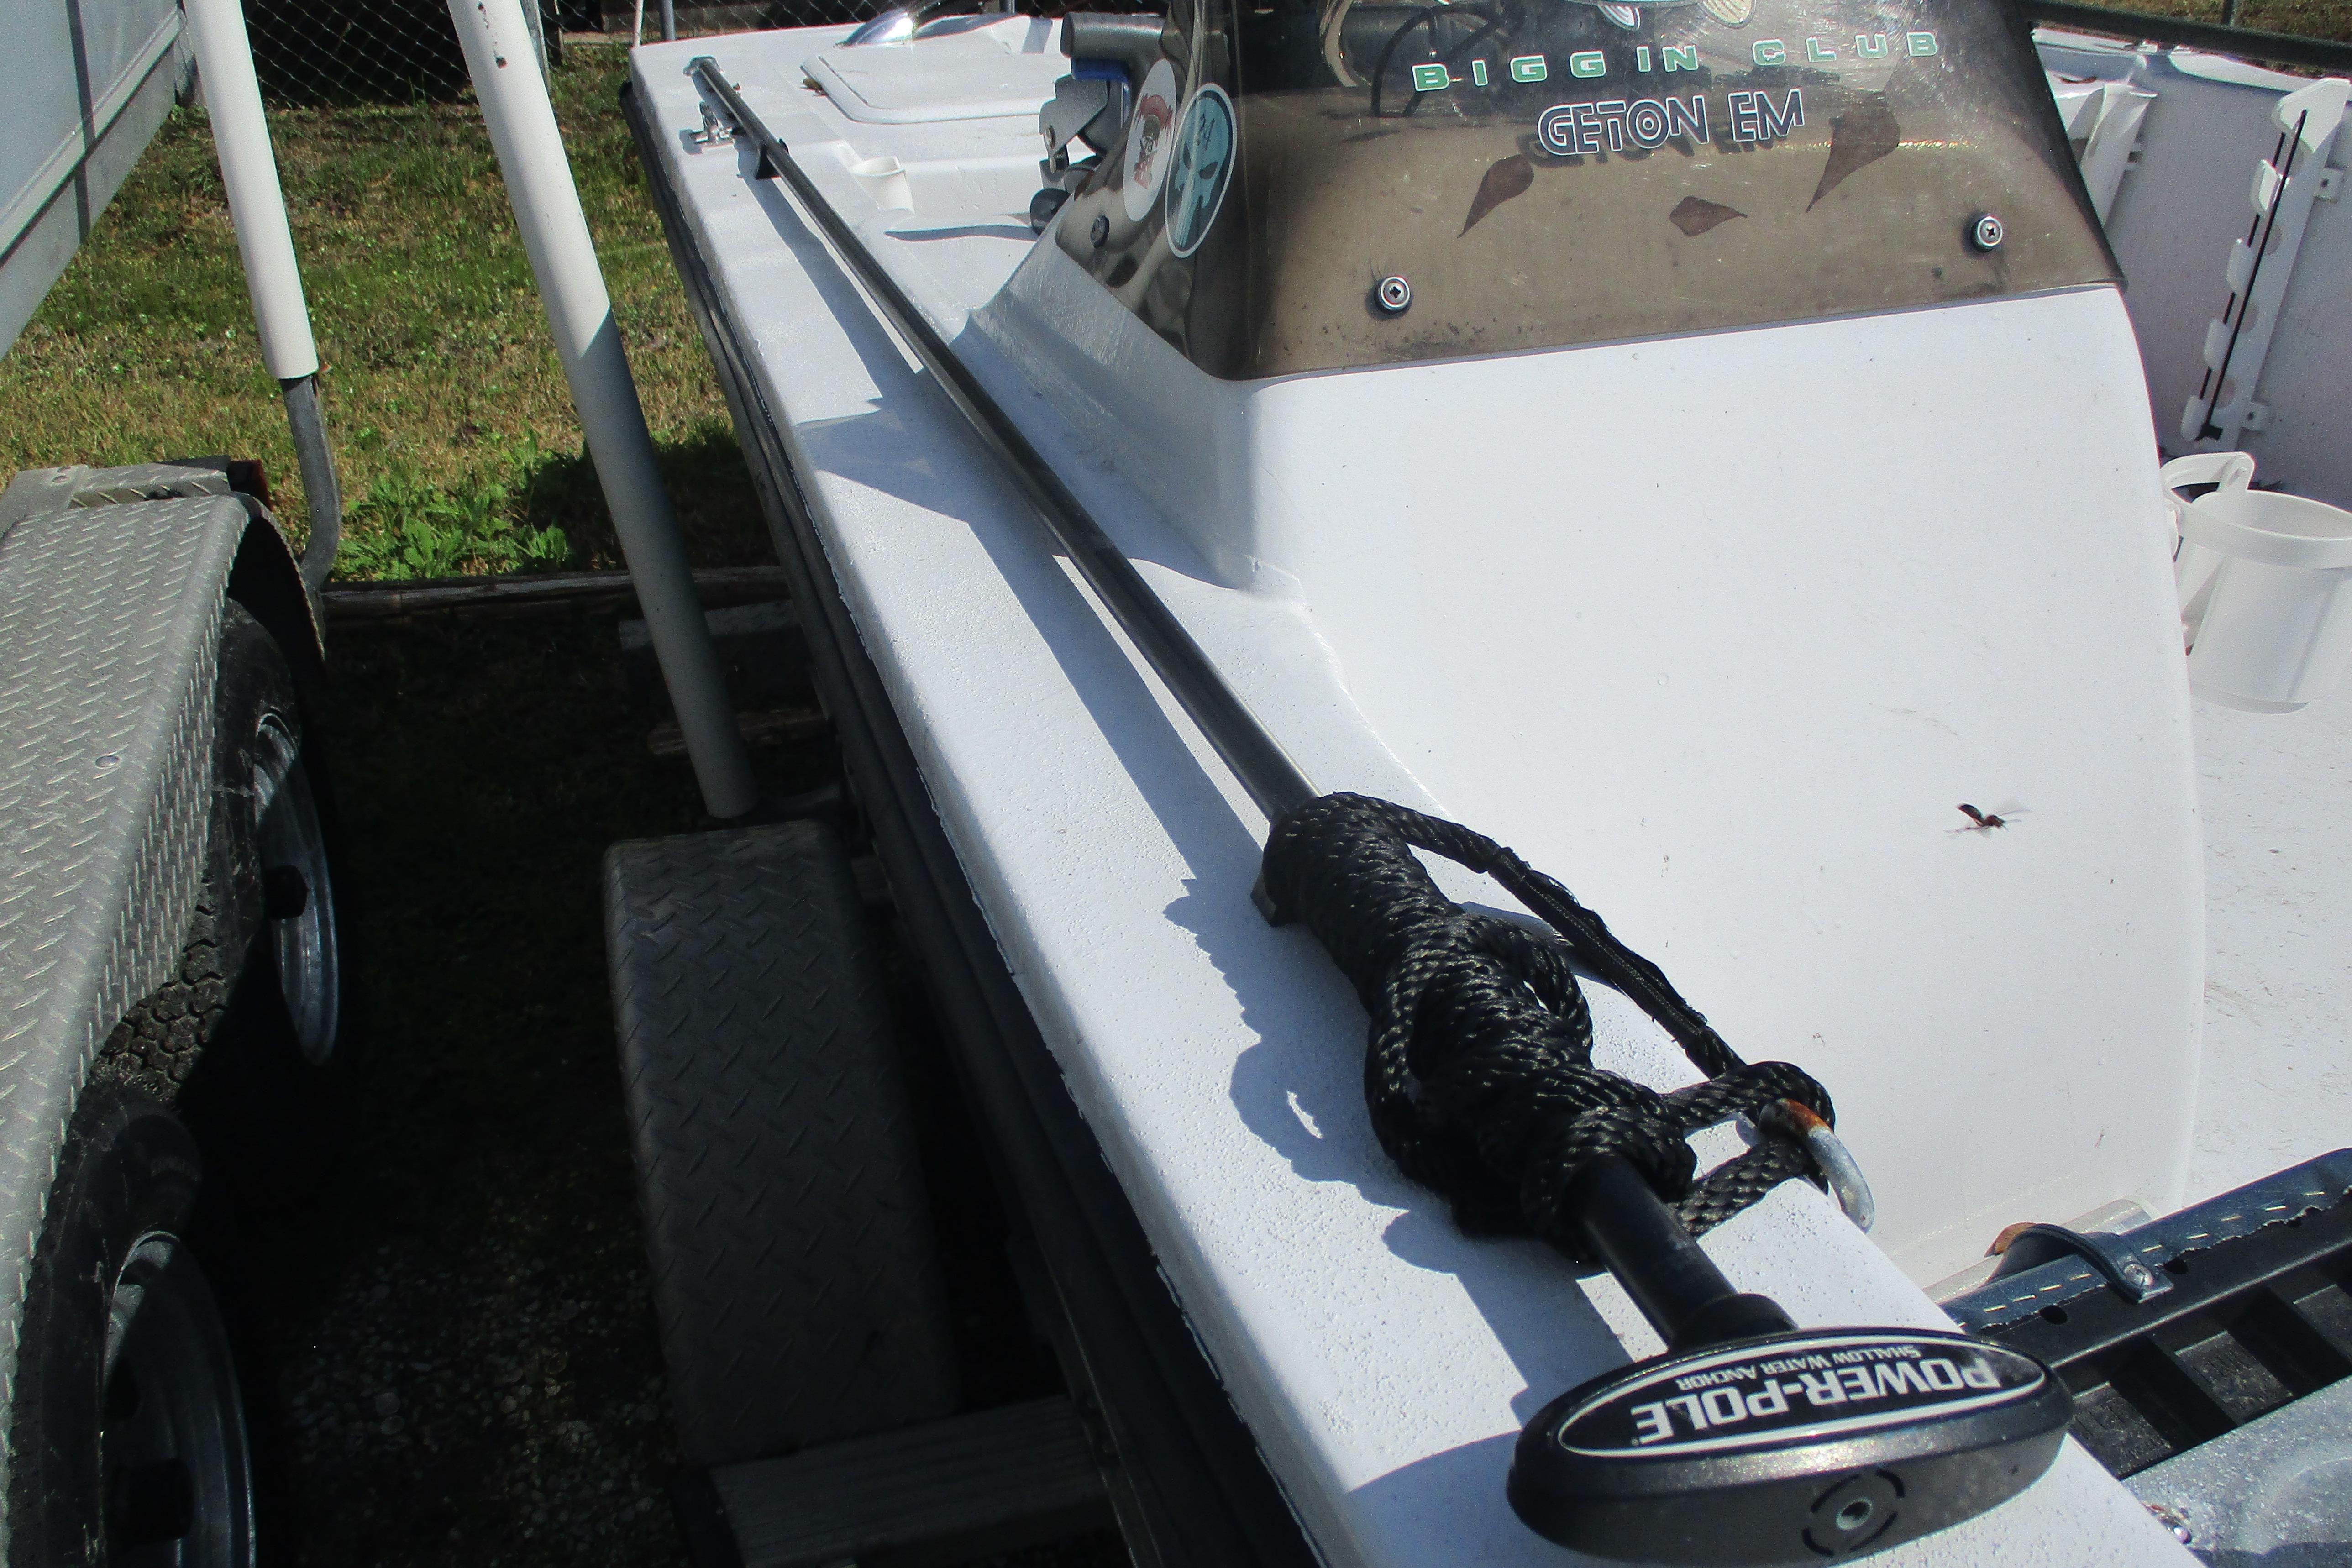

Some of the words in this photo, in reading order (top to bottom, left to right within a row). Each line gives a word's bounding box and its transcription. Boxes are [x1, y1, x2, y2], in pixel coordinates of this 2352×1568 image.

[1412, 45, 1699, 91] BIGGIN
[1752, 31, 1939, 67] CLUB
[1538, 94, 1710, 157] GETON
[1727, 89, 1805, 142] EM
[1761, 1352, 1832, 1374] WATER
[1832, 1345, 1922, 1365] SHALLOW
[1676, 1369, 1758, 1392] ANCHOR
[1630, 1357, 2002, 1446] POWER-POLE
